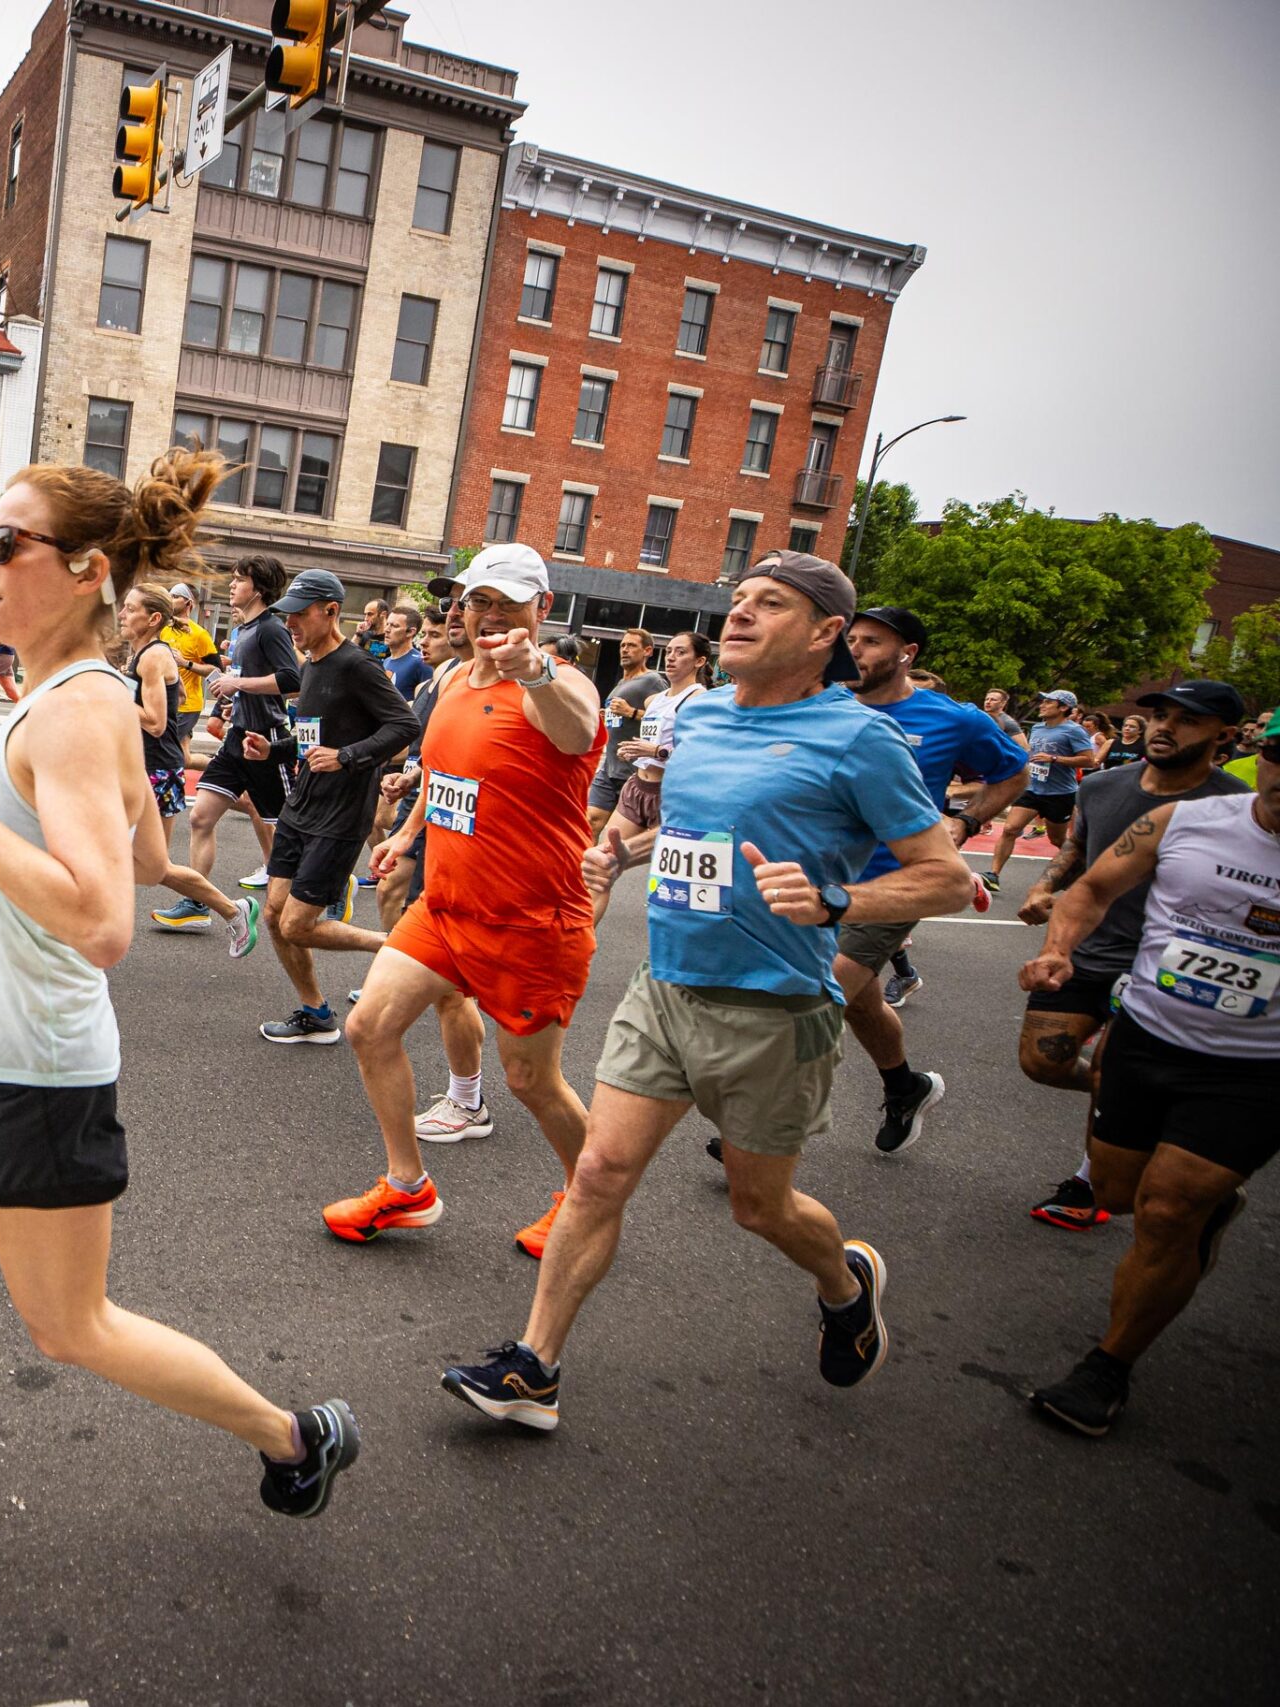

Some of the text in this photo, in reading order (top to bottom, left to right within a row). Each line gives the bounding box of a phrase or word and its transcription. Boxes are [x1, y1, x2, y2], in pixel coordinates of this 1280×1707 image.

[194, 112, 217, 143] ONLY
[428, 782, 477, 813] 17010
[658, 847, 718, 880] 8018
[696, 888, 708, 903] C
[1177, 949, 1262, 991] 7223
[1221, 995, 1238, 1009] C
